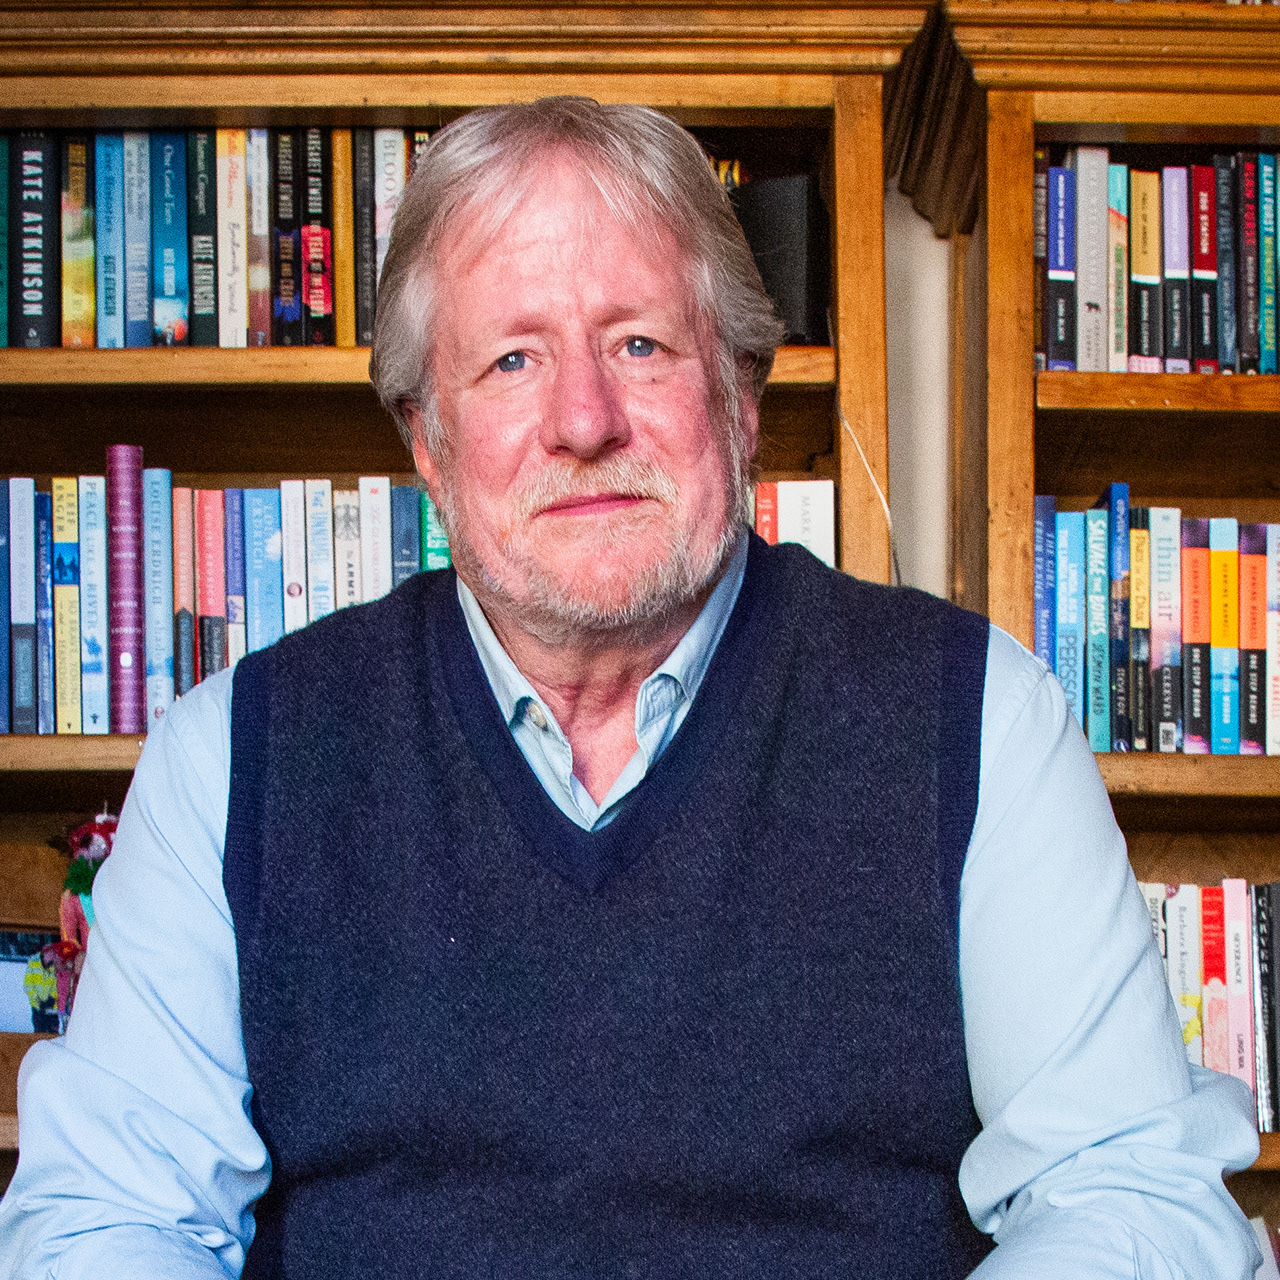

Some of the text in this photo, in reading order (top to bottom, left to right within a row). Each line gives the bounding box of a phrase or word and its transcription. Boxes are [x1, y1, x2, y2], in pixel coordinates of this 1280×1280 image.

[1263, 165, 1274, 196] ALAN
[22, 150, 43, 317] KATE ATKINSON
[1200, 214, 1209, 255] STATION
[1263, 197, 1275, 233] FURST
[85, 481, 98, 530] PEACE
[151, 479, 164, 606] LOUISE ERDRICH
[1089, 518, 1107, 574] SALVAGE
[1156, 536, 1177, 621] thin air
[1090, 595, 1107, 636] BONES
[1116, 697, 1127, 716] FOX
[1162, 666, 1173, 718] CLEEVES
